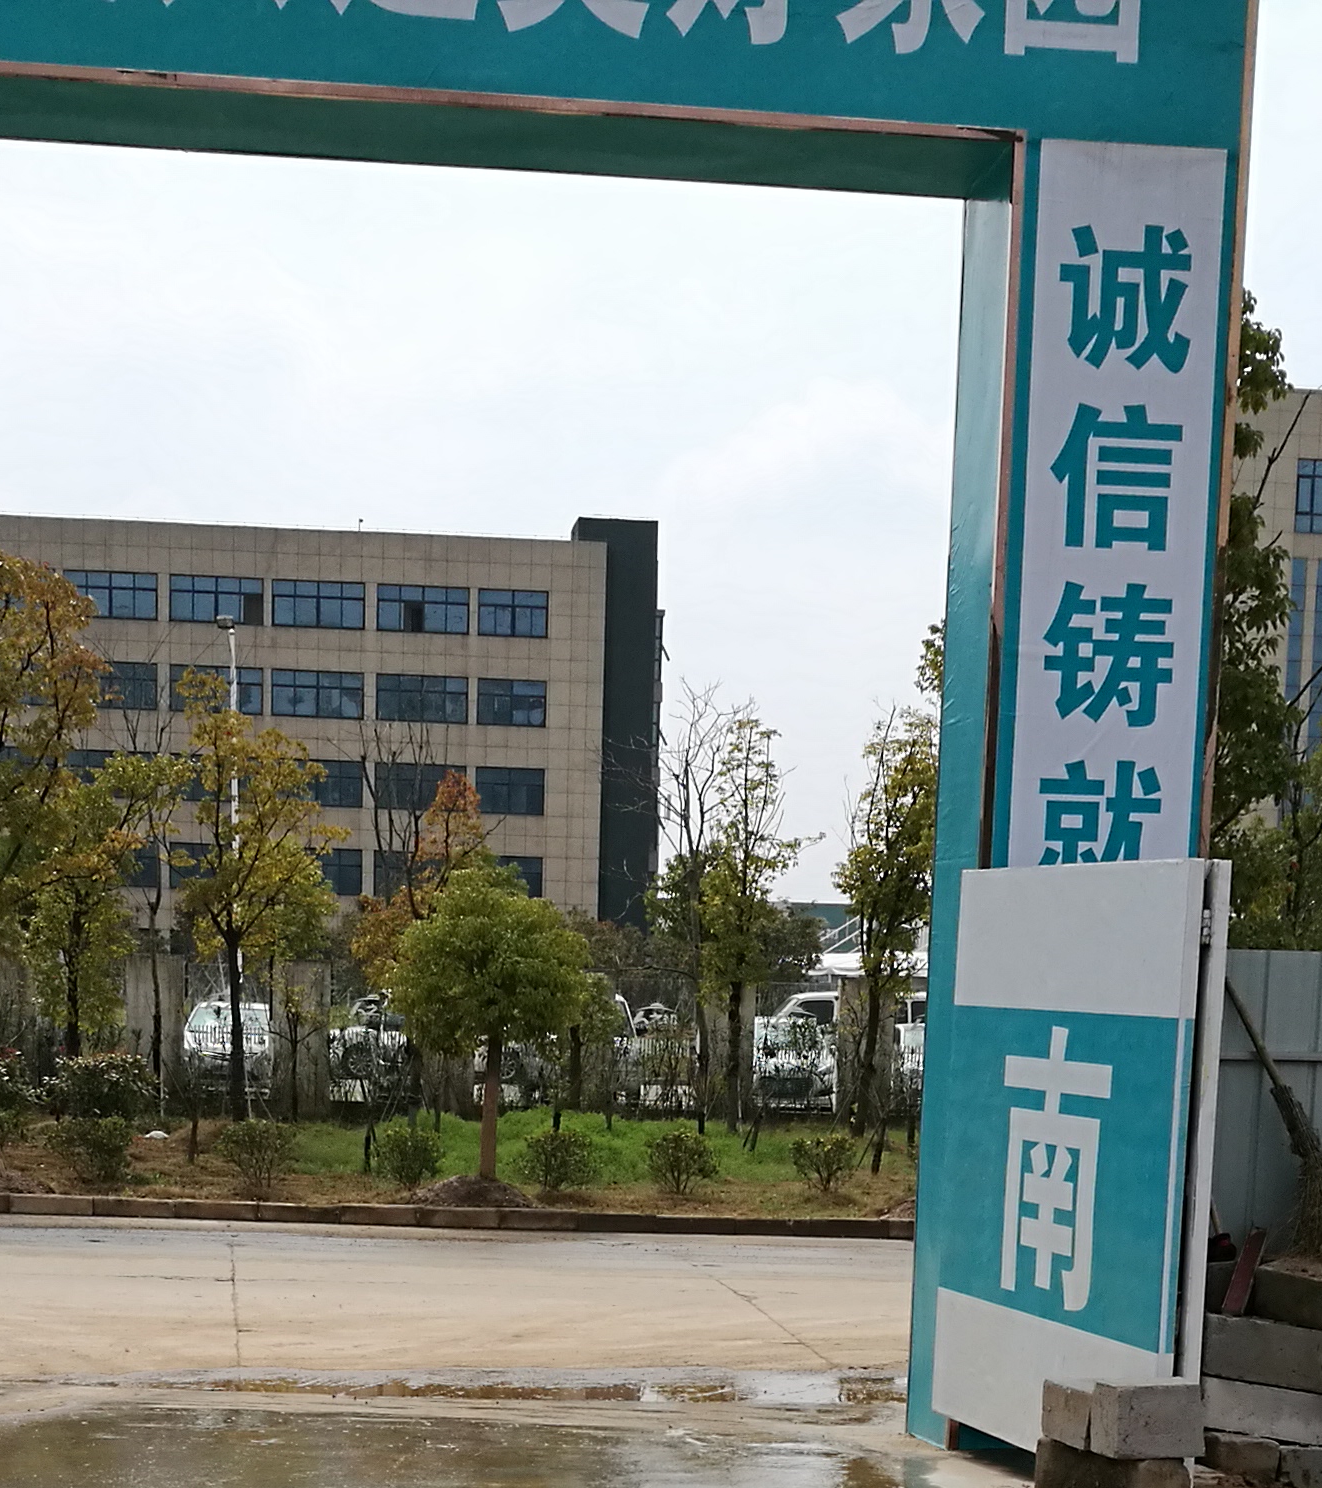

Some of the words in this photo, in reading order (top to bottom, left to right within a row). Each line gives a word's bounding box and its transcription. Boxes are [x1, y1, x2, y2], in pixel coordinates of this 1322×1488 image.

[1038, 224, 1192, 866] 诚信铸就
[999, 1025, 1113, 1312] 南
